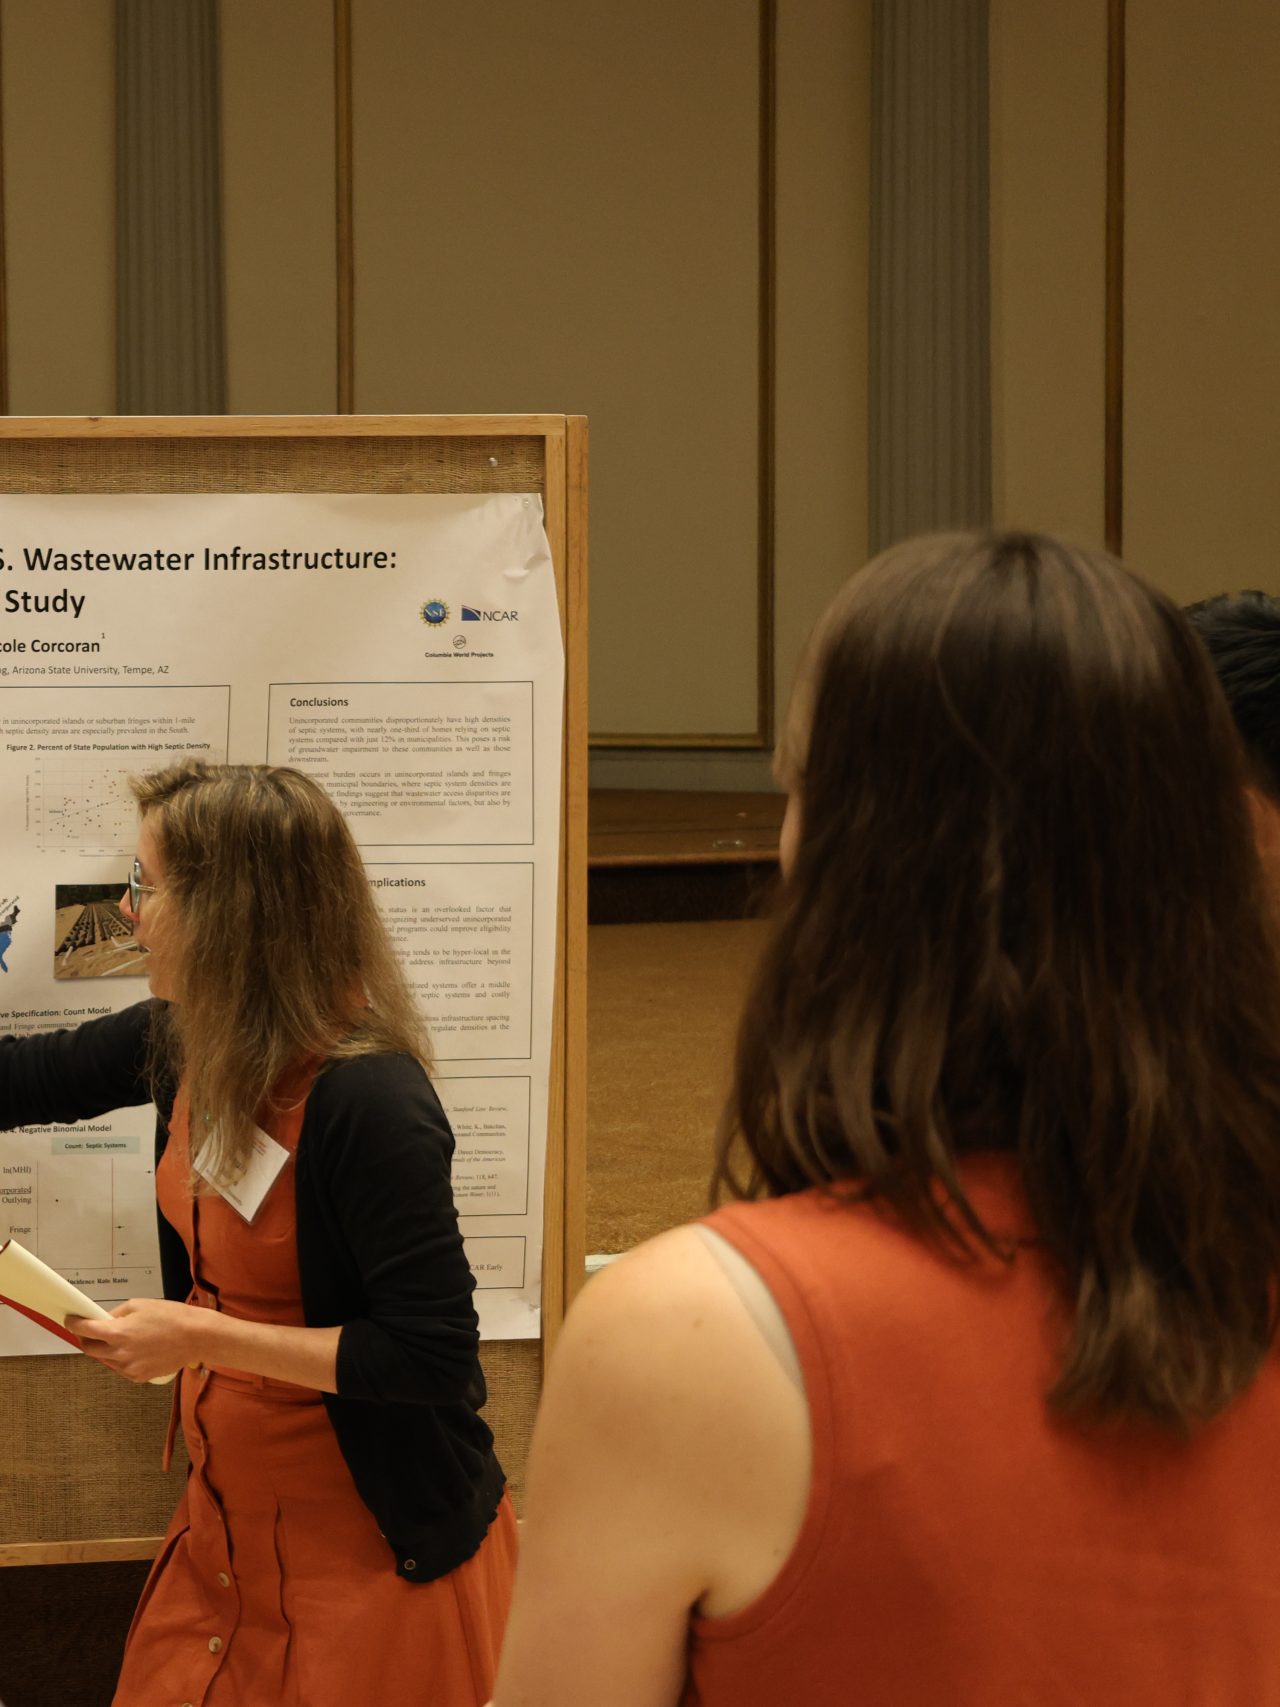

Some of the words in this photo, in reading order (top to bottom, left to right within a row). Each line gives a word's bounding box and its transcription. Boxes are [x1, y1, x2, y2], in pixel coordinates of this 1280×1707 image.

[23, 548, 194, 570] Wastewater
[204, 547, 395, 570] Infrastructure:
[5, 589, 85, 617] Study
[482, 610, 519, 621] NCAR
[30, 639, 99, 652] Corcoran
[48, 665, 70, 674] State
[122, 665, 154, 675] Tempe,
[289, 697, 348, 706] Conclusions
[368, 878, 426, 888] mplications
[11, 1009, 61, 1018] Specification:
